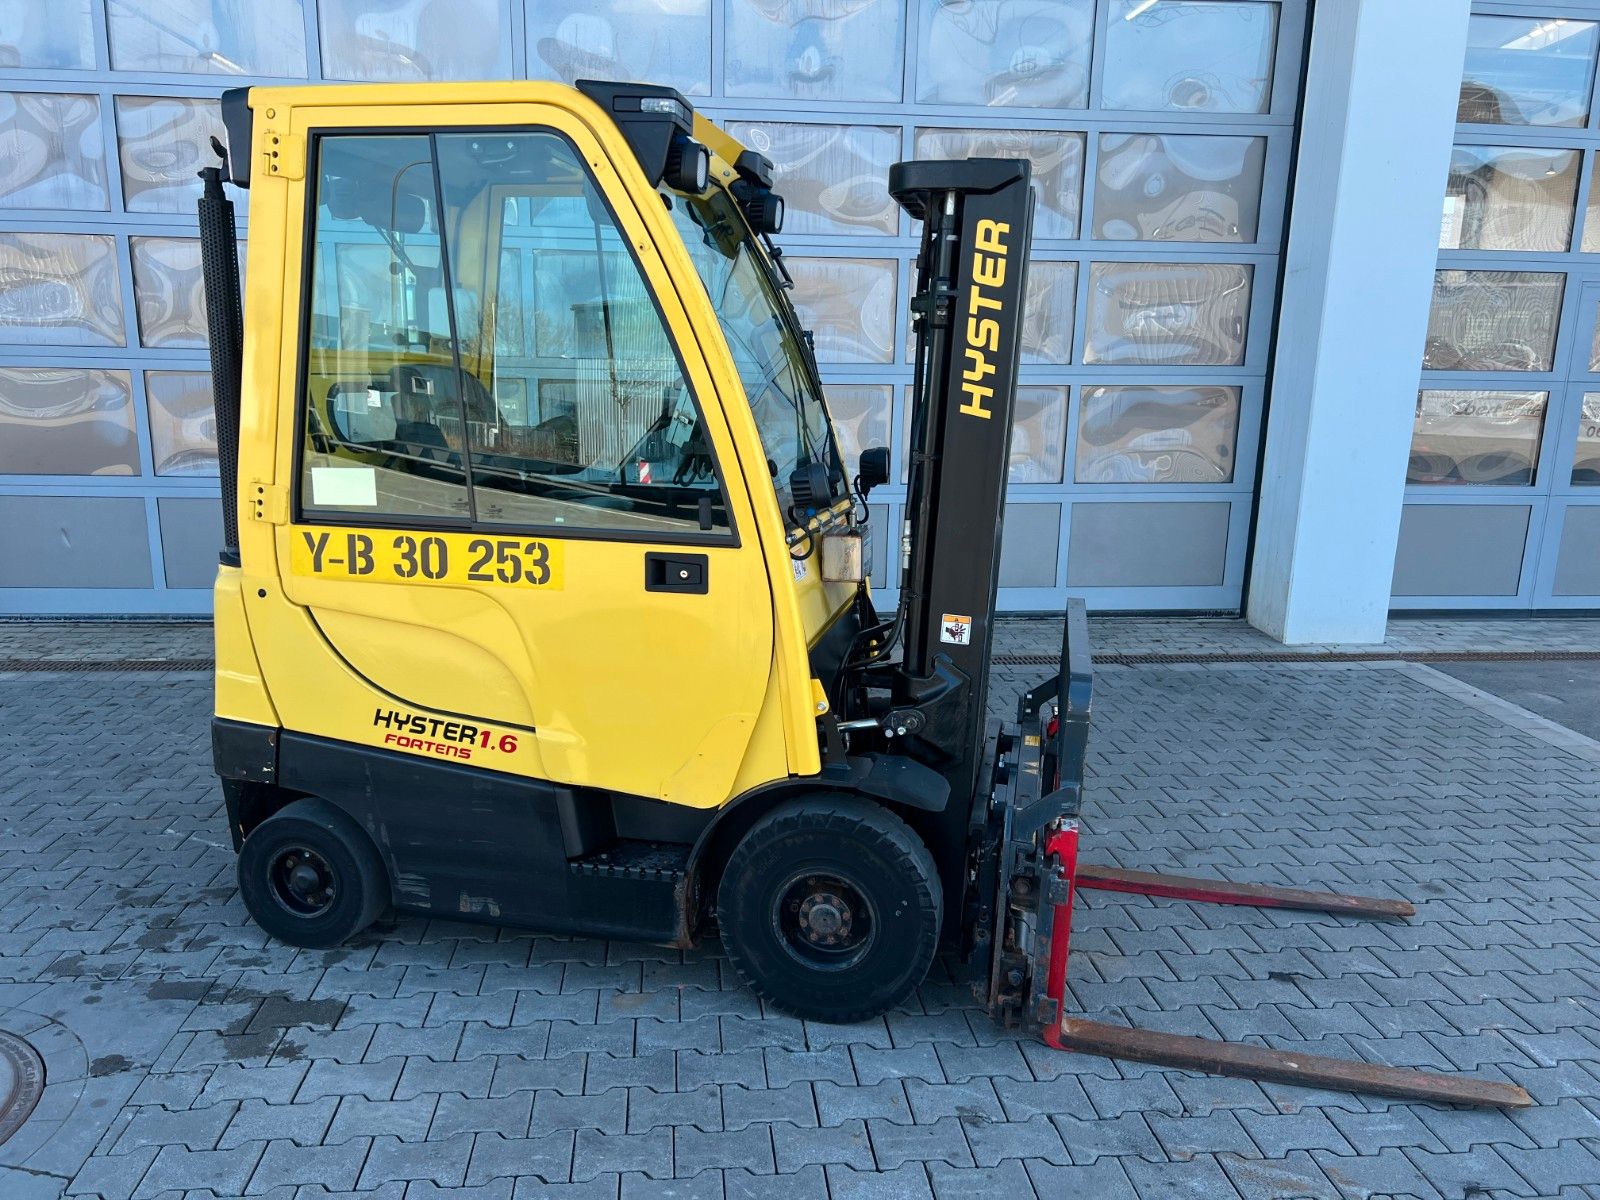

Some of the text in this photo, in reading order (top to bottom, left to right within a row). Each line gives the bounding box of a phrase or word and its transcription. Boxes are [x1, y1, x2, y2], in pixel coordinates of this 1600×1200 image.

[959, 219, 1010, 419] HYSTER
[303, 532, 551, 585] Y-B 30 253
[373, 709, 518, 754] HYSTER 1.6
[384, 733, 472, 760] FORTENS
